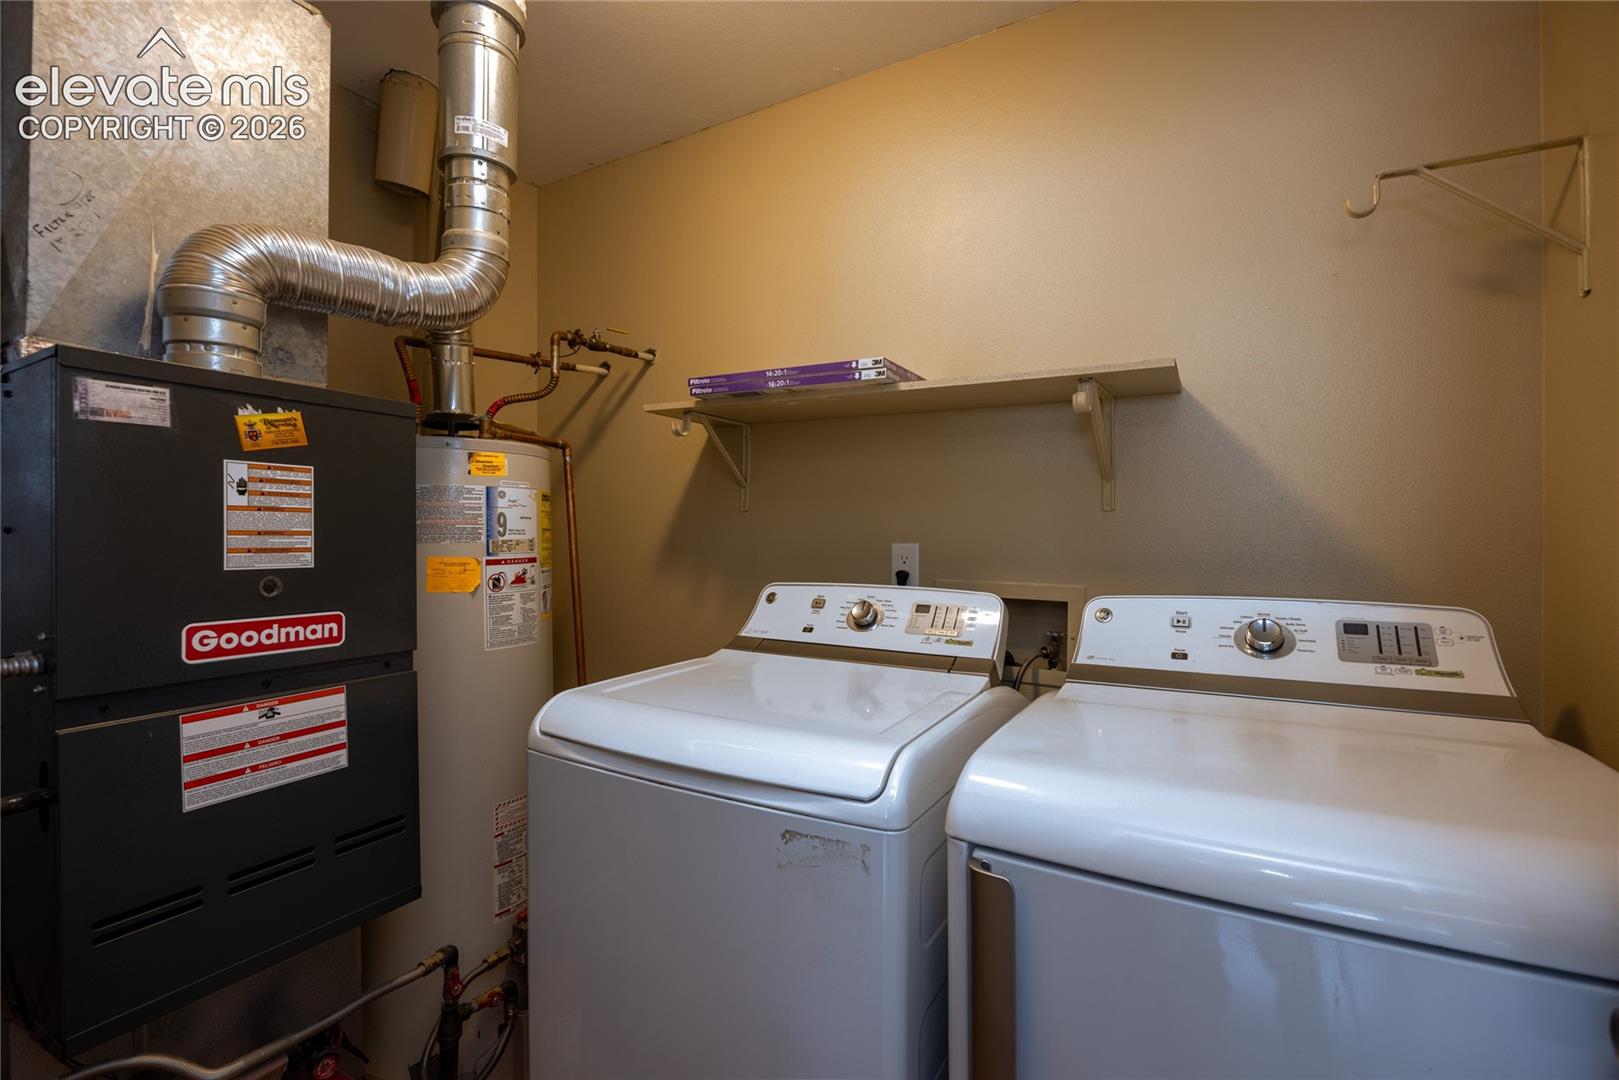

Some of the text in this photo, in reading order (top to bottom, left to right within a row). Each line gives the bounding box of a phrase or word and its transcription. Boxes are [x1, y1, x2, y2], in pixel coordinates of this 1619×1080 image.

[871, 358, 883, 366] 3M
[874, 370, 886, 378] 3M
[497, 512, 507, 537] 9
[191, 622, 339, 652] Goodman
[256, 700, 280, 709] DANGER
